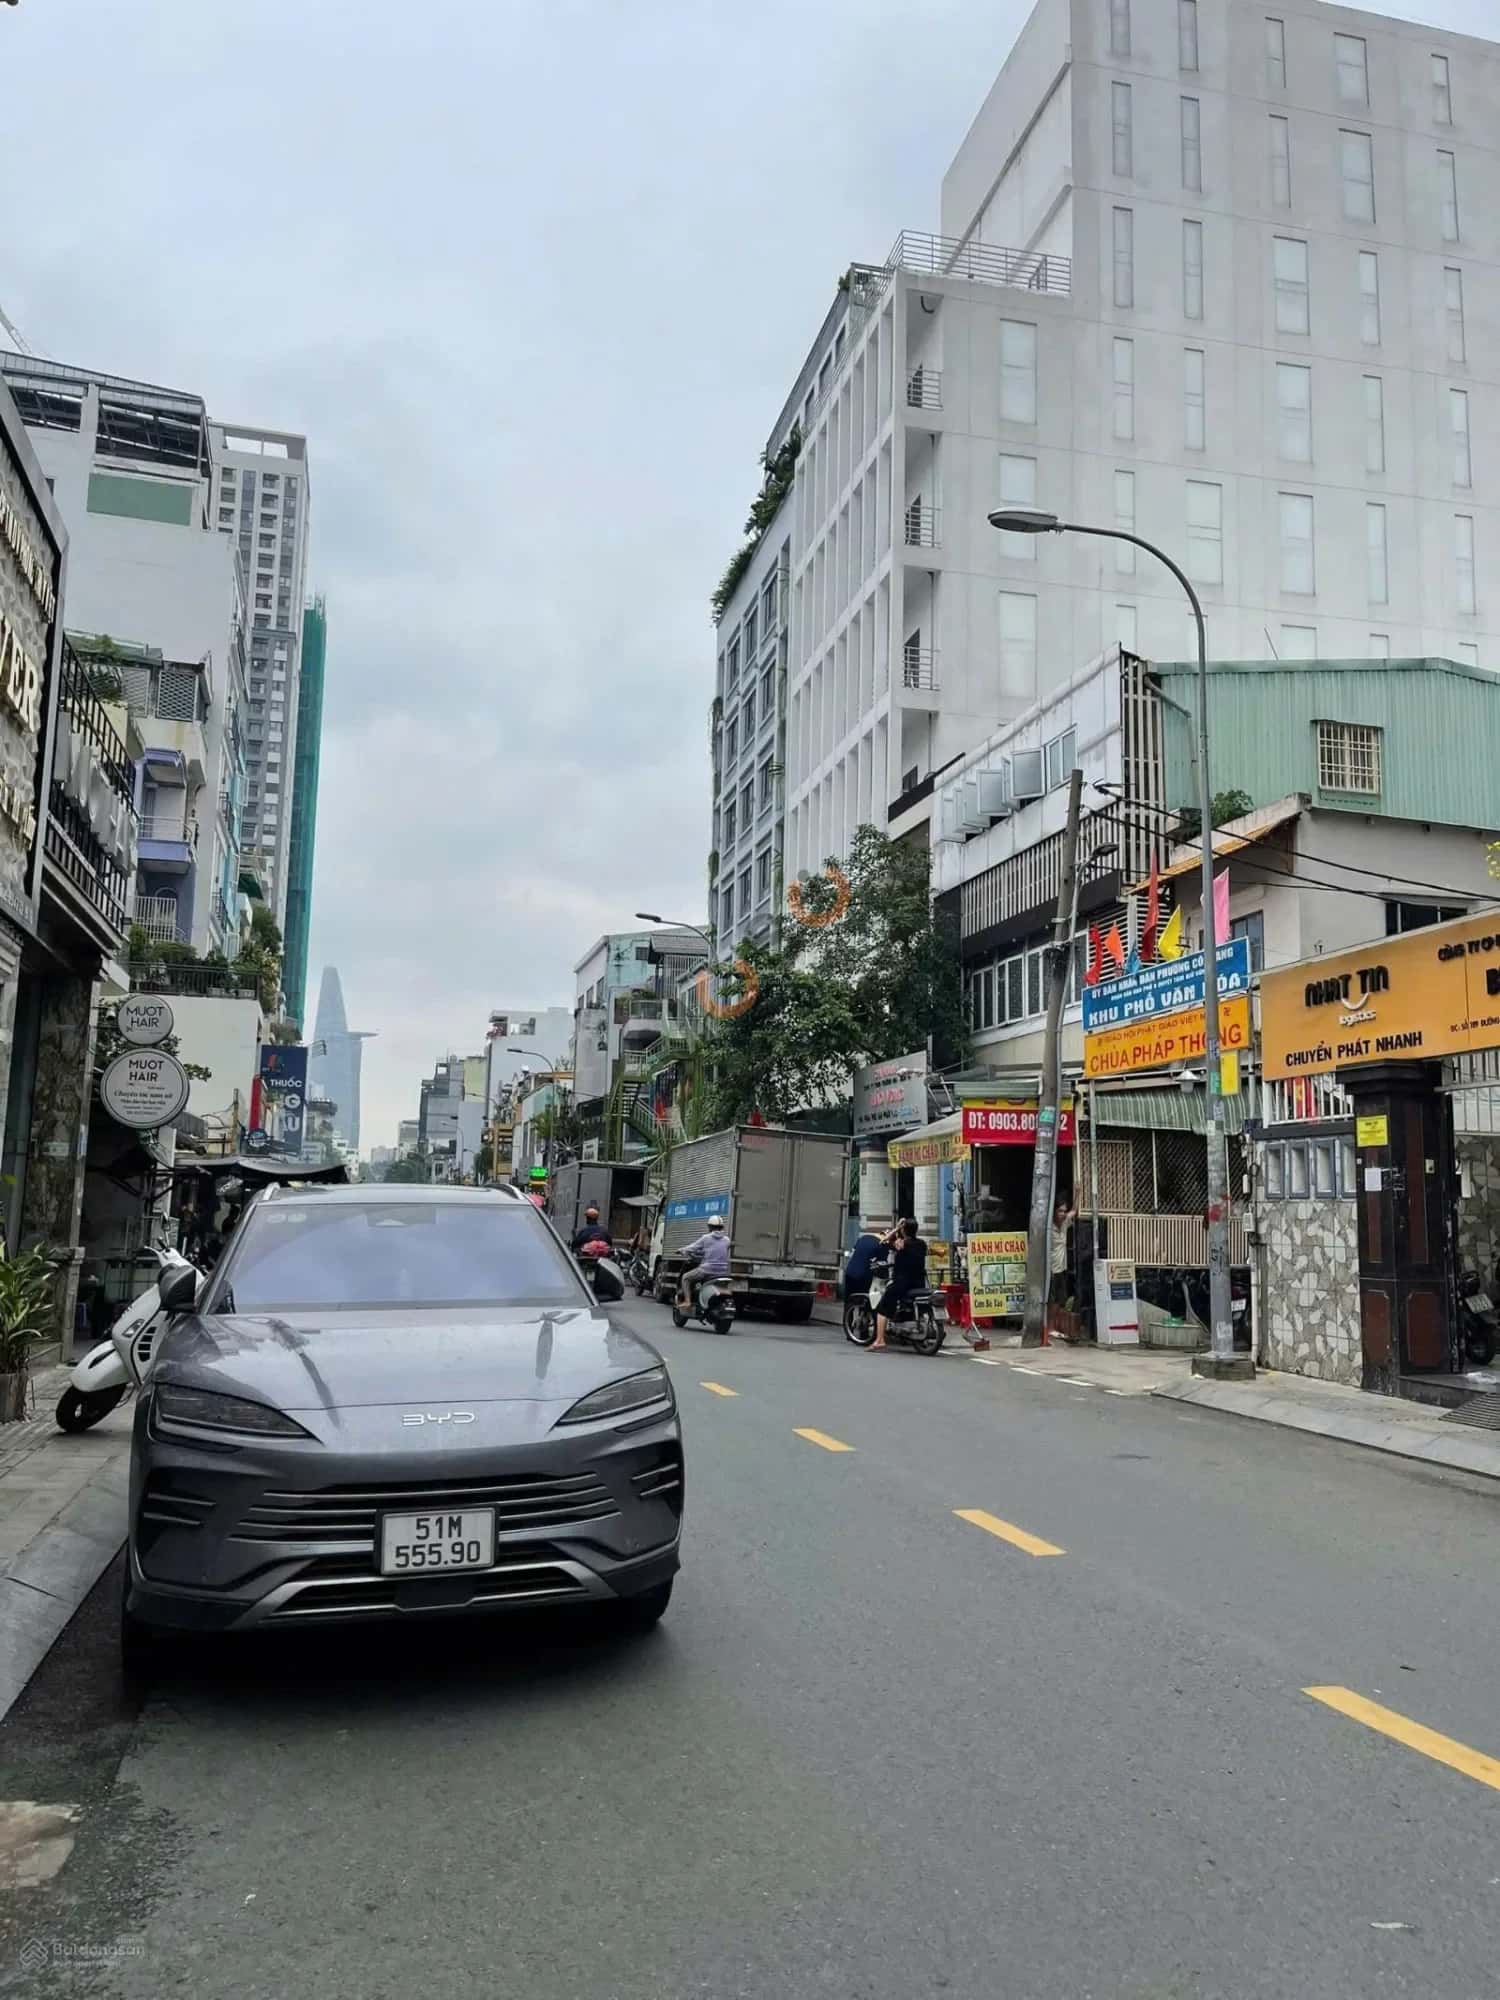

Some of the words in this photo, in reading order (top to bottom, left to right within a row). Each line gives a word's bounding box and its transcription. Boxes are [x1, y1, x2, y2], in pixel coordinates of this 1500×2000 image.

[126, 1006, 164, 1018] MUOT
[1089, 1005, 1118, 1027] KHU
[1124, 991, 1155, 1017] PHỐ
[1160, 985, 1196, 1007] VĂN
[130, 1017, 160, 1029] HAIR
[1132, 1034, 1175, 1065] PHÁP
[1286, 1040, 1333, 1068] CHUYỂN
[1337, 1037, 1371, 1059] PHÁT
[1376, 1031, 1423, 1053] NHANH
[128, 1060, 165, 1072] MUOT
[129, 1071, 159, 1083] HAIR
[270, 1076, 303, 1089] THUỐC
[402, 1411, 475, 1427] BYD
[415, 1515, 463, 1541] 51M
[394, 1540, 481, 1569] 555.90
